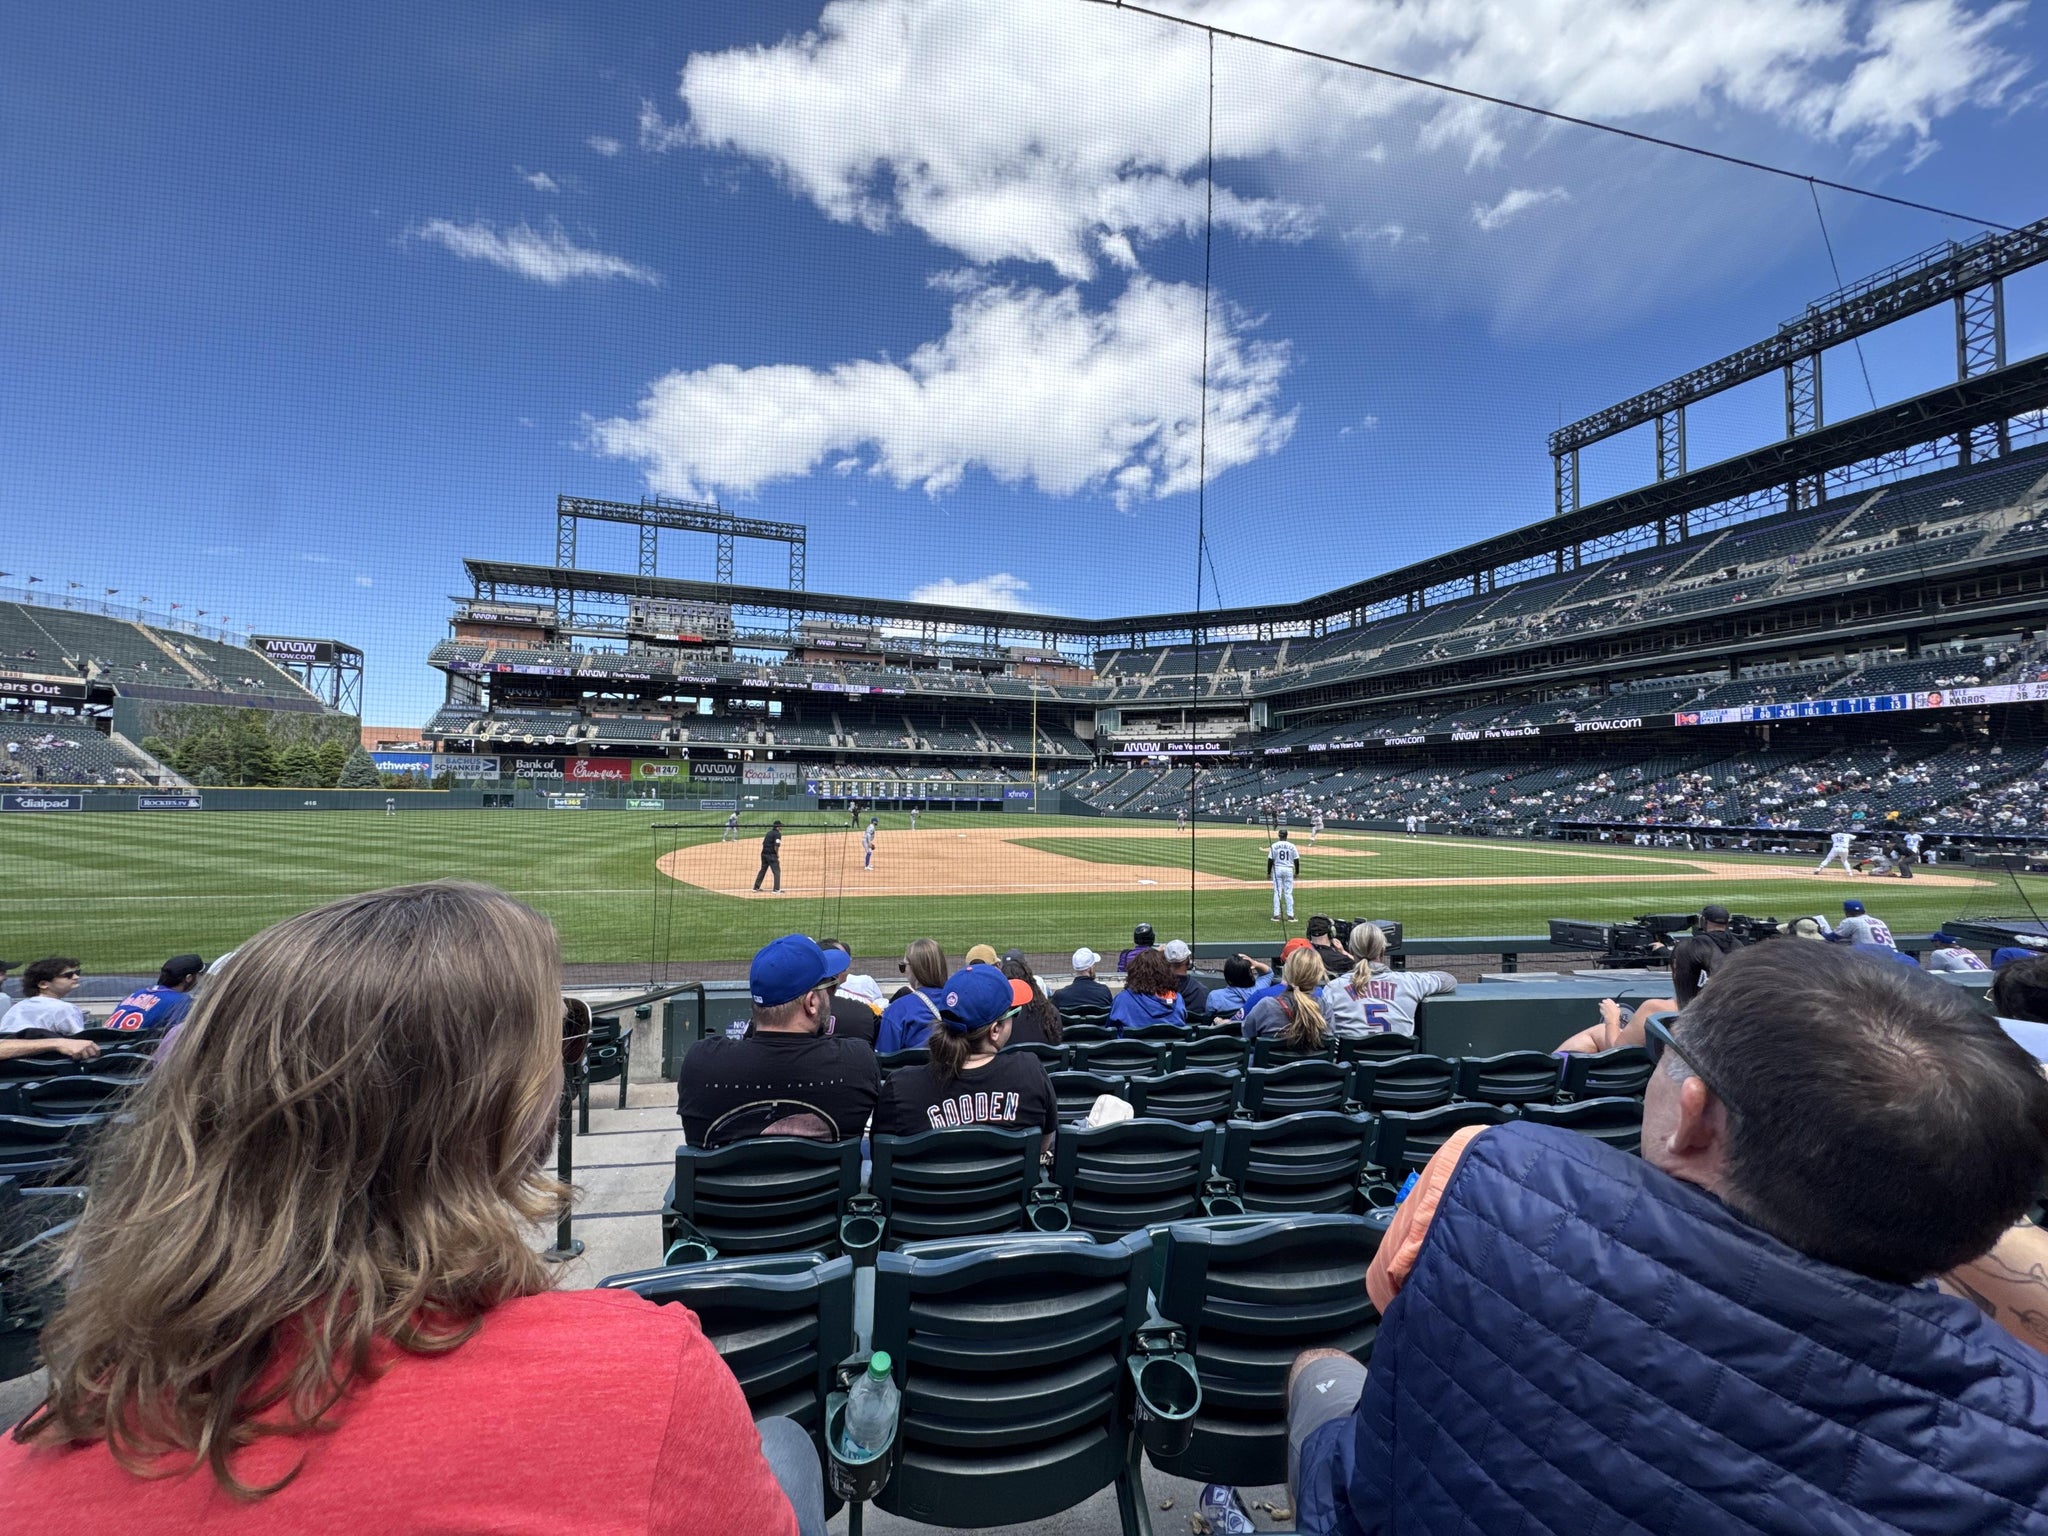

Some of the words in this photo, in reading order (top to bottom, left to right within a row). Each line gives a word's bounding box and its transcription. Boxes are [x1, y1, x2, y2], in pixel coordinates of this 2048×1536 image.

[266, 640, 317, 653] ARROW
[266, 652, 316, 660] arrow.com
[576, 669, 608, 678] ARROW
[677, 676, 717, 684] arrow.com
[742, 679, 770, 687] ARROW
[0, 682, 28, 692] ars
[31, 683, 61, 694] Out
[2016, 692, 2028, 700] 3B
[2032, 690, 2048, 698] .22
[1890, 700, 1901, 709] 13
[1949, 695, 1986, 705] KARROS
[1850, 704, 1854, 712] 1
[1780, 709, 1795, 718] 3.48
[1702, 716, 1720, 724] SCOTT
[1574, 718, 1642, 732] arrow.com
[1451, 732, 1480, 741] ARROW
[1484, 730, 1500, 738] Five
[1501, 728, 1523, 737] Years
[1524, 727, 1540, 736] Out
[1384, 736, 1425, 746] arrow.com
[1123, 742, 1160, 752] ARROW
[1184, 742, 1204, 750] Years
[1206, 742, 1220, 750] Out
[1264, 746, 1292, 755] arrow.com
[1308, 744, 1326, 752] ARROW
[1330, 742, 1340, 750] Five
[376, 761, 422, 770] uthwest
[446, 757, 481, 765] BACHUS
[516, 759, 542, 769] Bank
[542, 759, 555, 769] of
[434, 764, 481, 772] SCHANKER
[694, 764, 736, 774] ARROW
[516, 768, 564, 779] Colorado
[745, 769, 772, 779] Coors
[1008, 790, 1029, 799] xfinity
[21, 799, 69, 810] dialpad
[1279, 850, 1290, 861] 81
[1870, 926, 1893, 944] 65
[1344, 980, 1398, 1002] WIGHT
[1363, 1004, 1392, 1032] 5
[926, 1092, 1019, 1129] GOODEN
